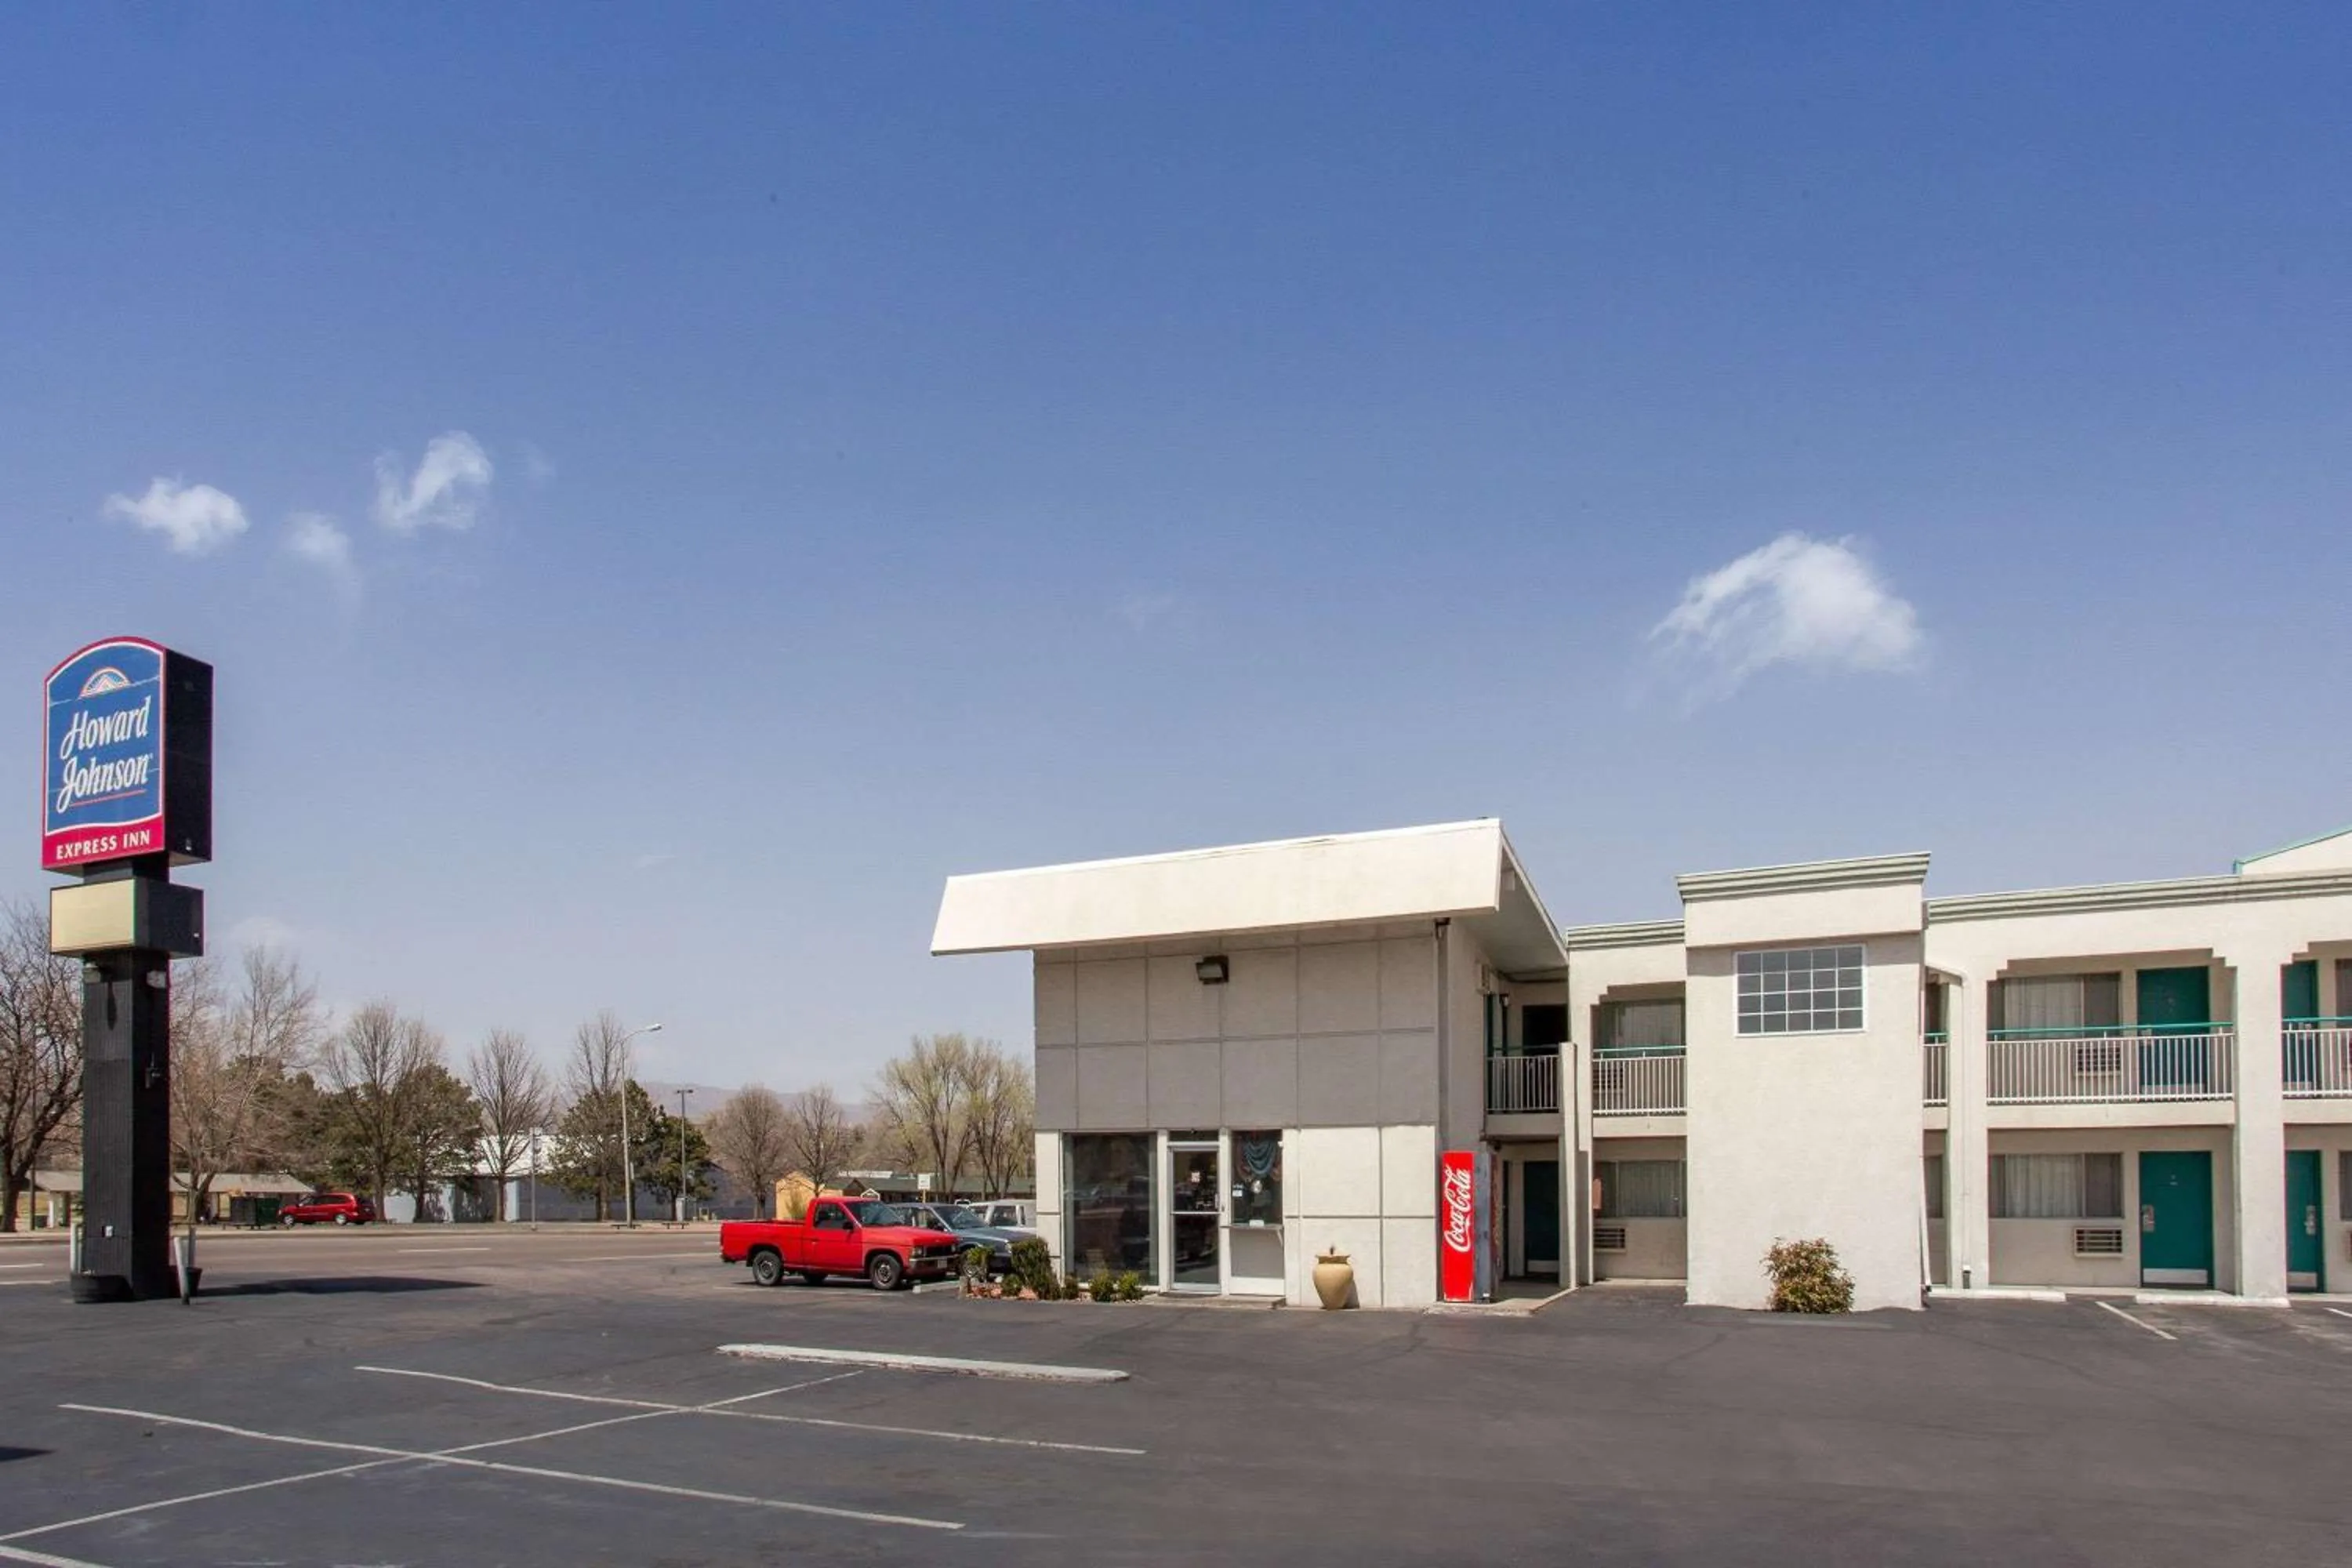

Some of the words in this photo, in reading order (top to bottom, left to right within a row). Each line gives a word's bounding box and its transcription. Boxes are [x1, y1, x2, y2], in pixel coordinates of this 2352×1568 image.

[60, 695, 151, 760] Howard
[56, 753, 151, 814] Johnson
[56, 835, 118, 860] EXPRESS
[122, 829, 151, 849] INN
[1443, 1163, 1472, 1253] Coca-Cola
